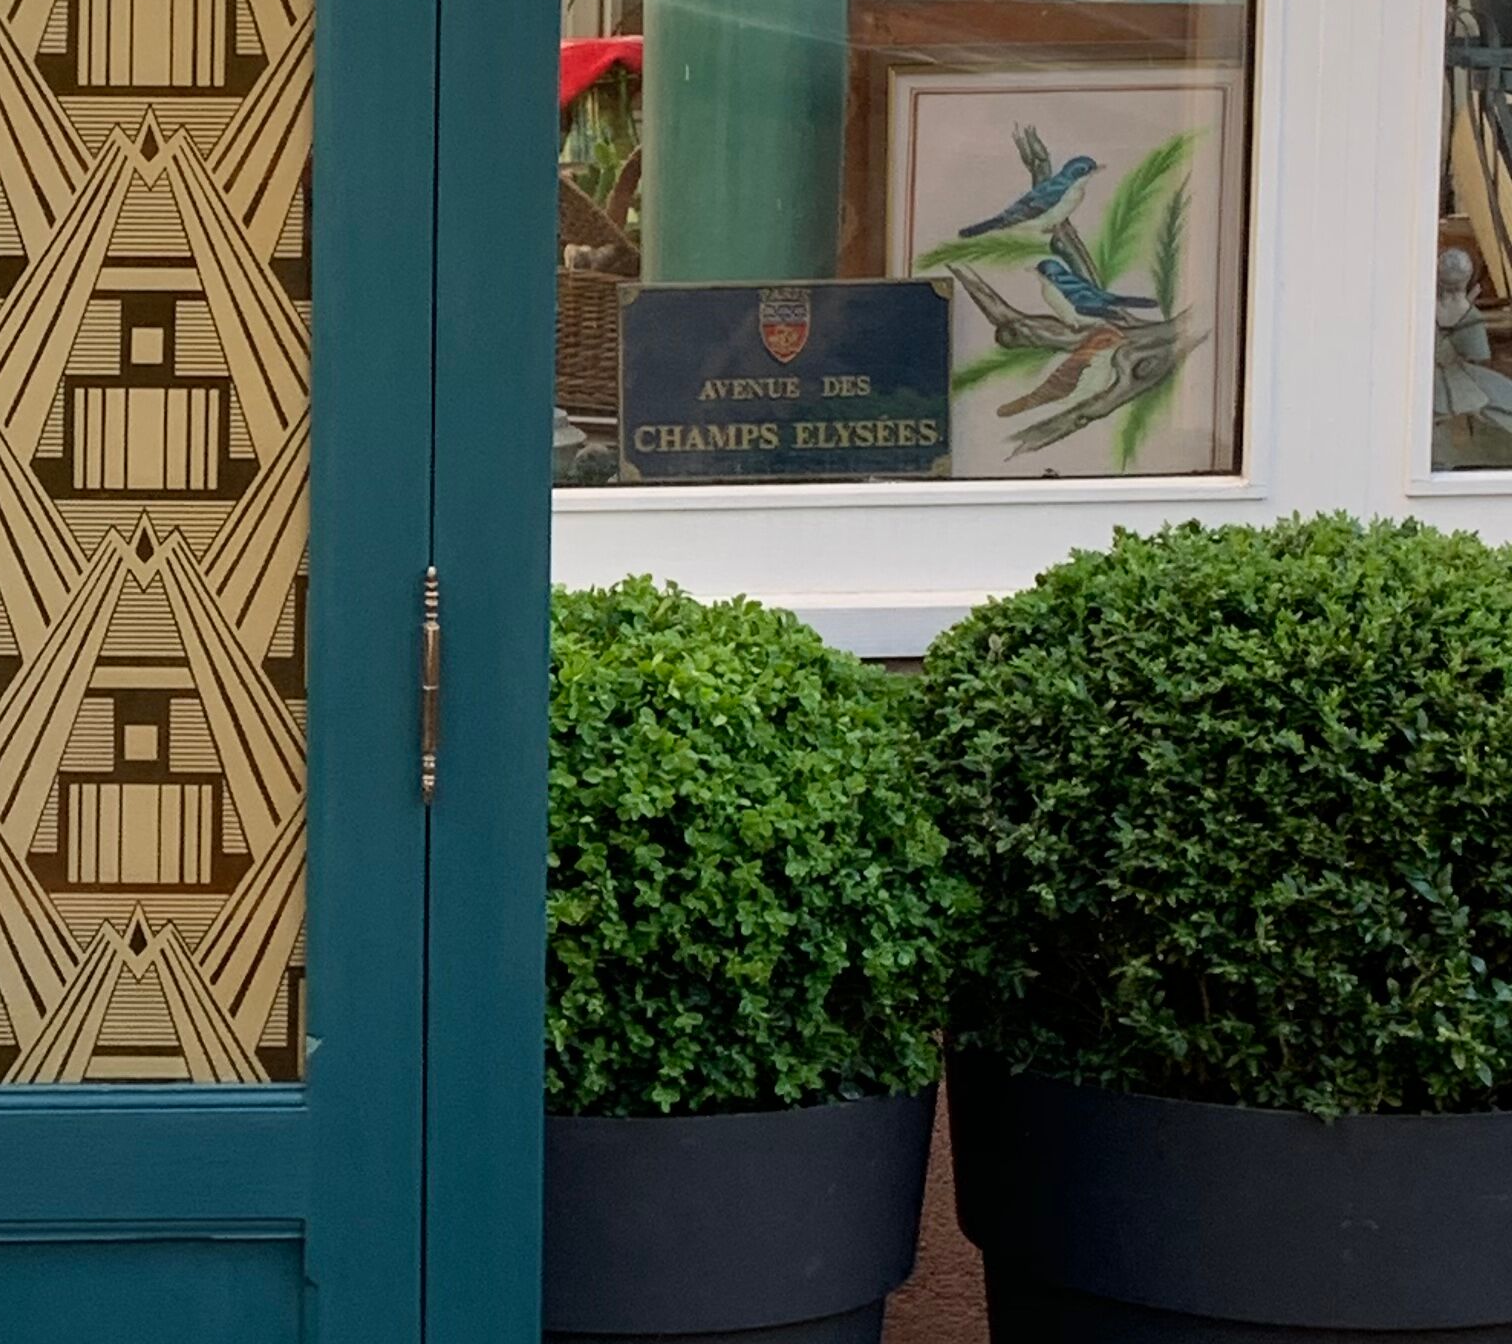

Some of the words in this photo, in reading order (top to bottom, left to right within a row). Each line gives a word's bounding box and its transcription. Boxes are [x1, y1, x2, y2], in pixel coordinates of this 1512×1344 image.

[698, 376, 801, 400] AVENUE
[821, 375, 871, 397] DES
[633, 422, 780, 453] CHAMPS
